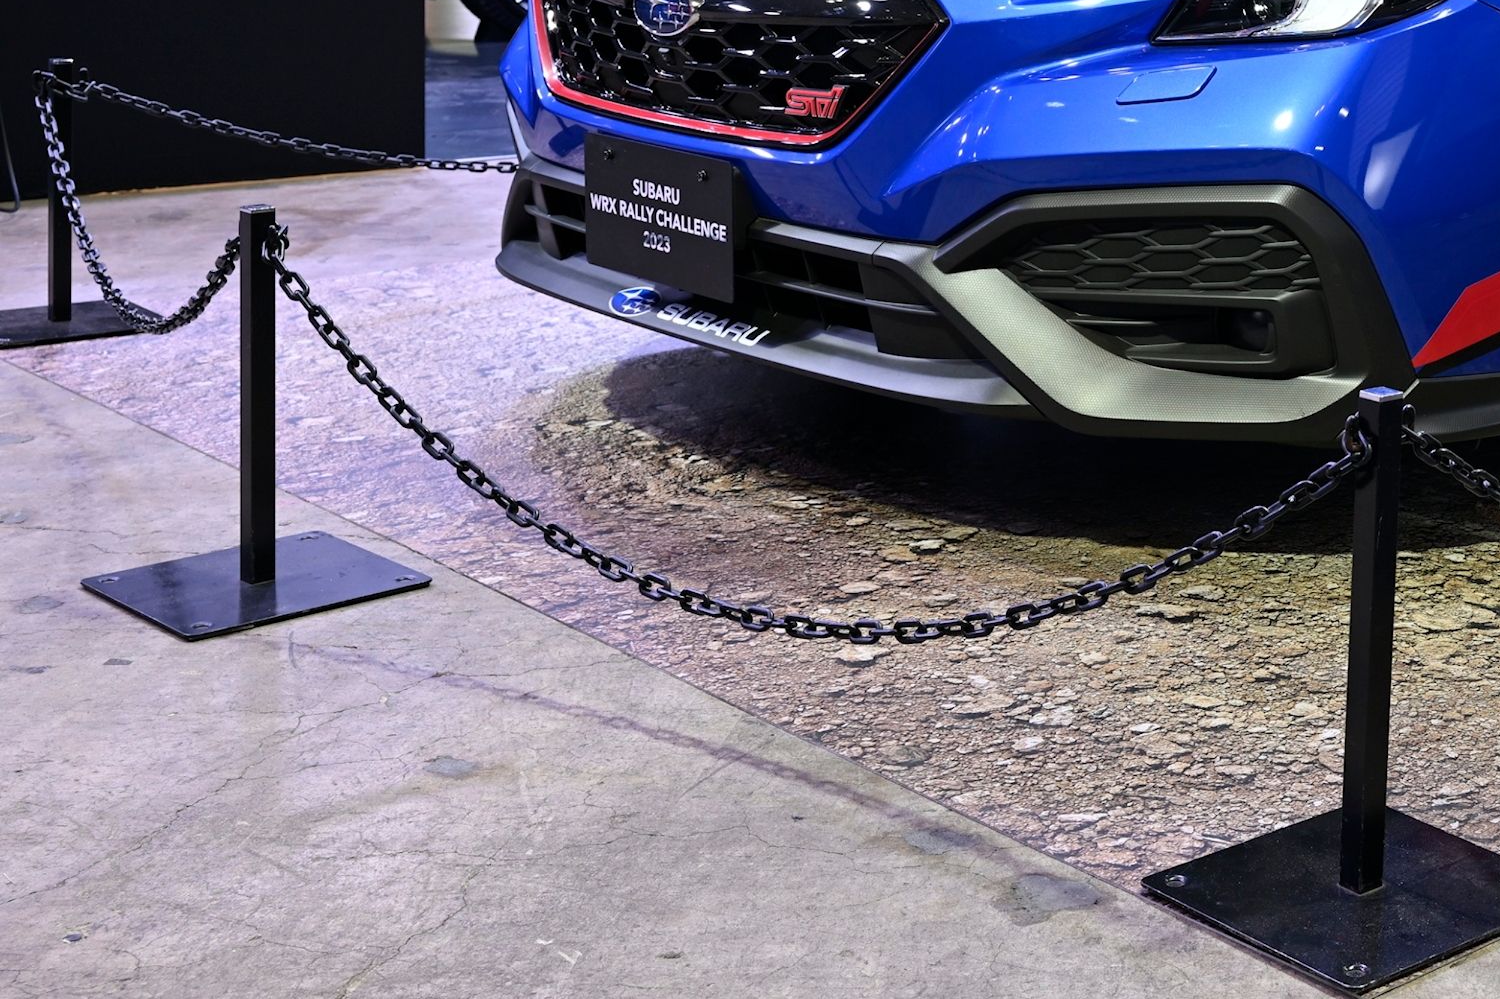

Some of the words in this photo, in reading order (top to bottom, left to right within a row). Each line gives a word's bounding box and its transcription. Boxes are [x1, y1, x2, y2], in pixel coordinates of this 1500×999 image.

[632, 178, 680, 206] SUBARU
[590, 192, 618, 215] WRX
[619, 200, 656, 224] RALLY
[656, 209, 728, 243] CHALLENGE
[643, 230, 671, 253] 2023
[657, 303, 771, 347] SUBARU
